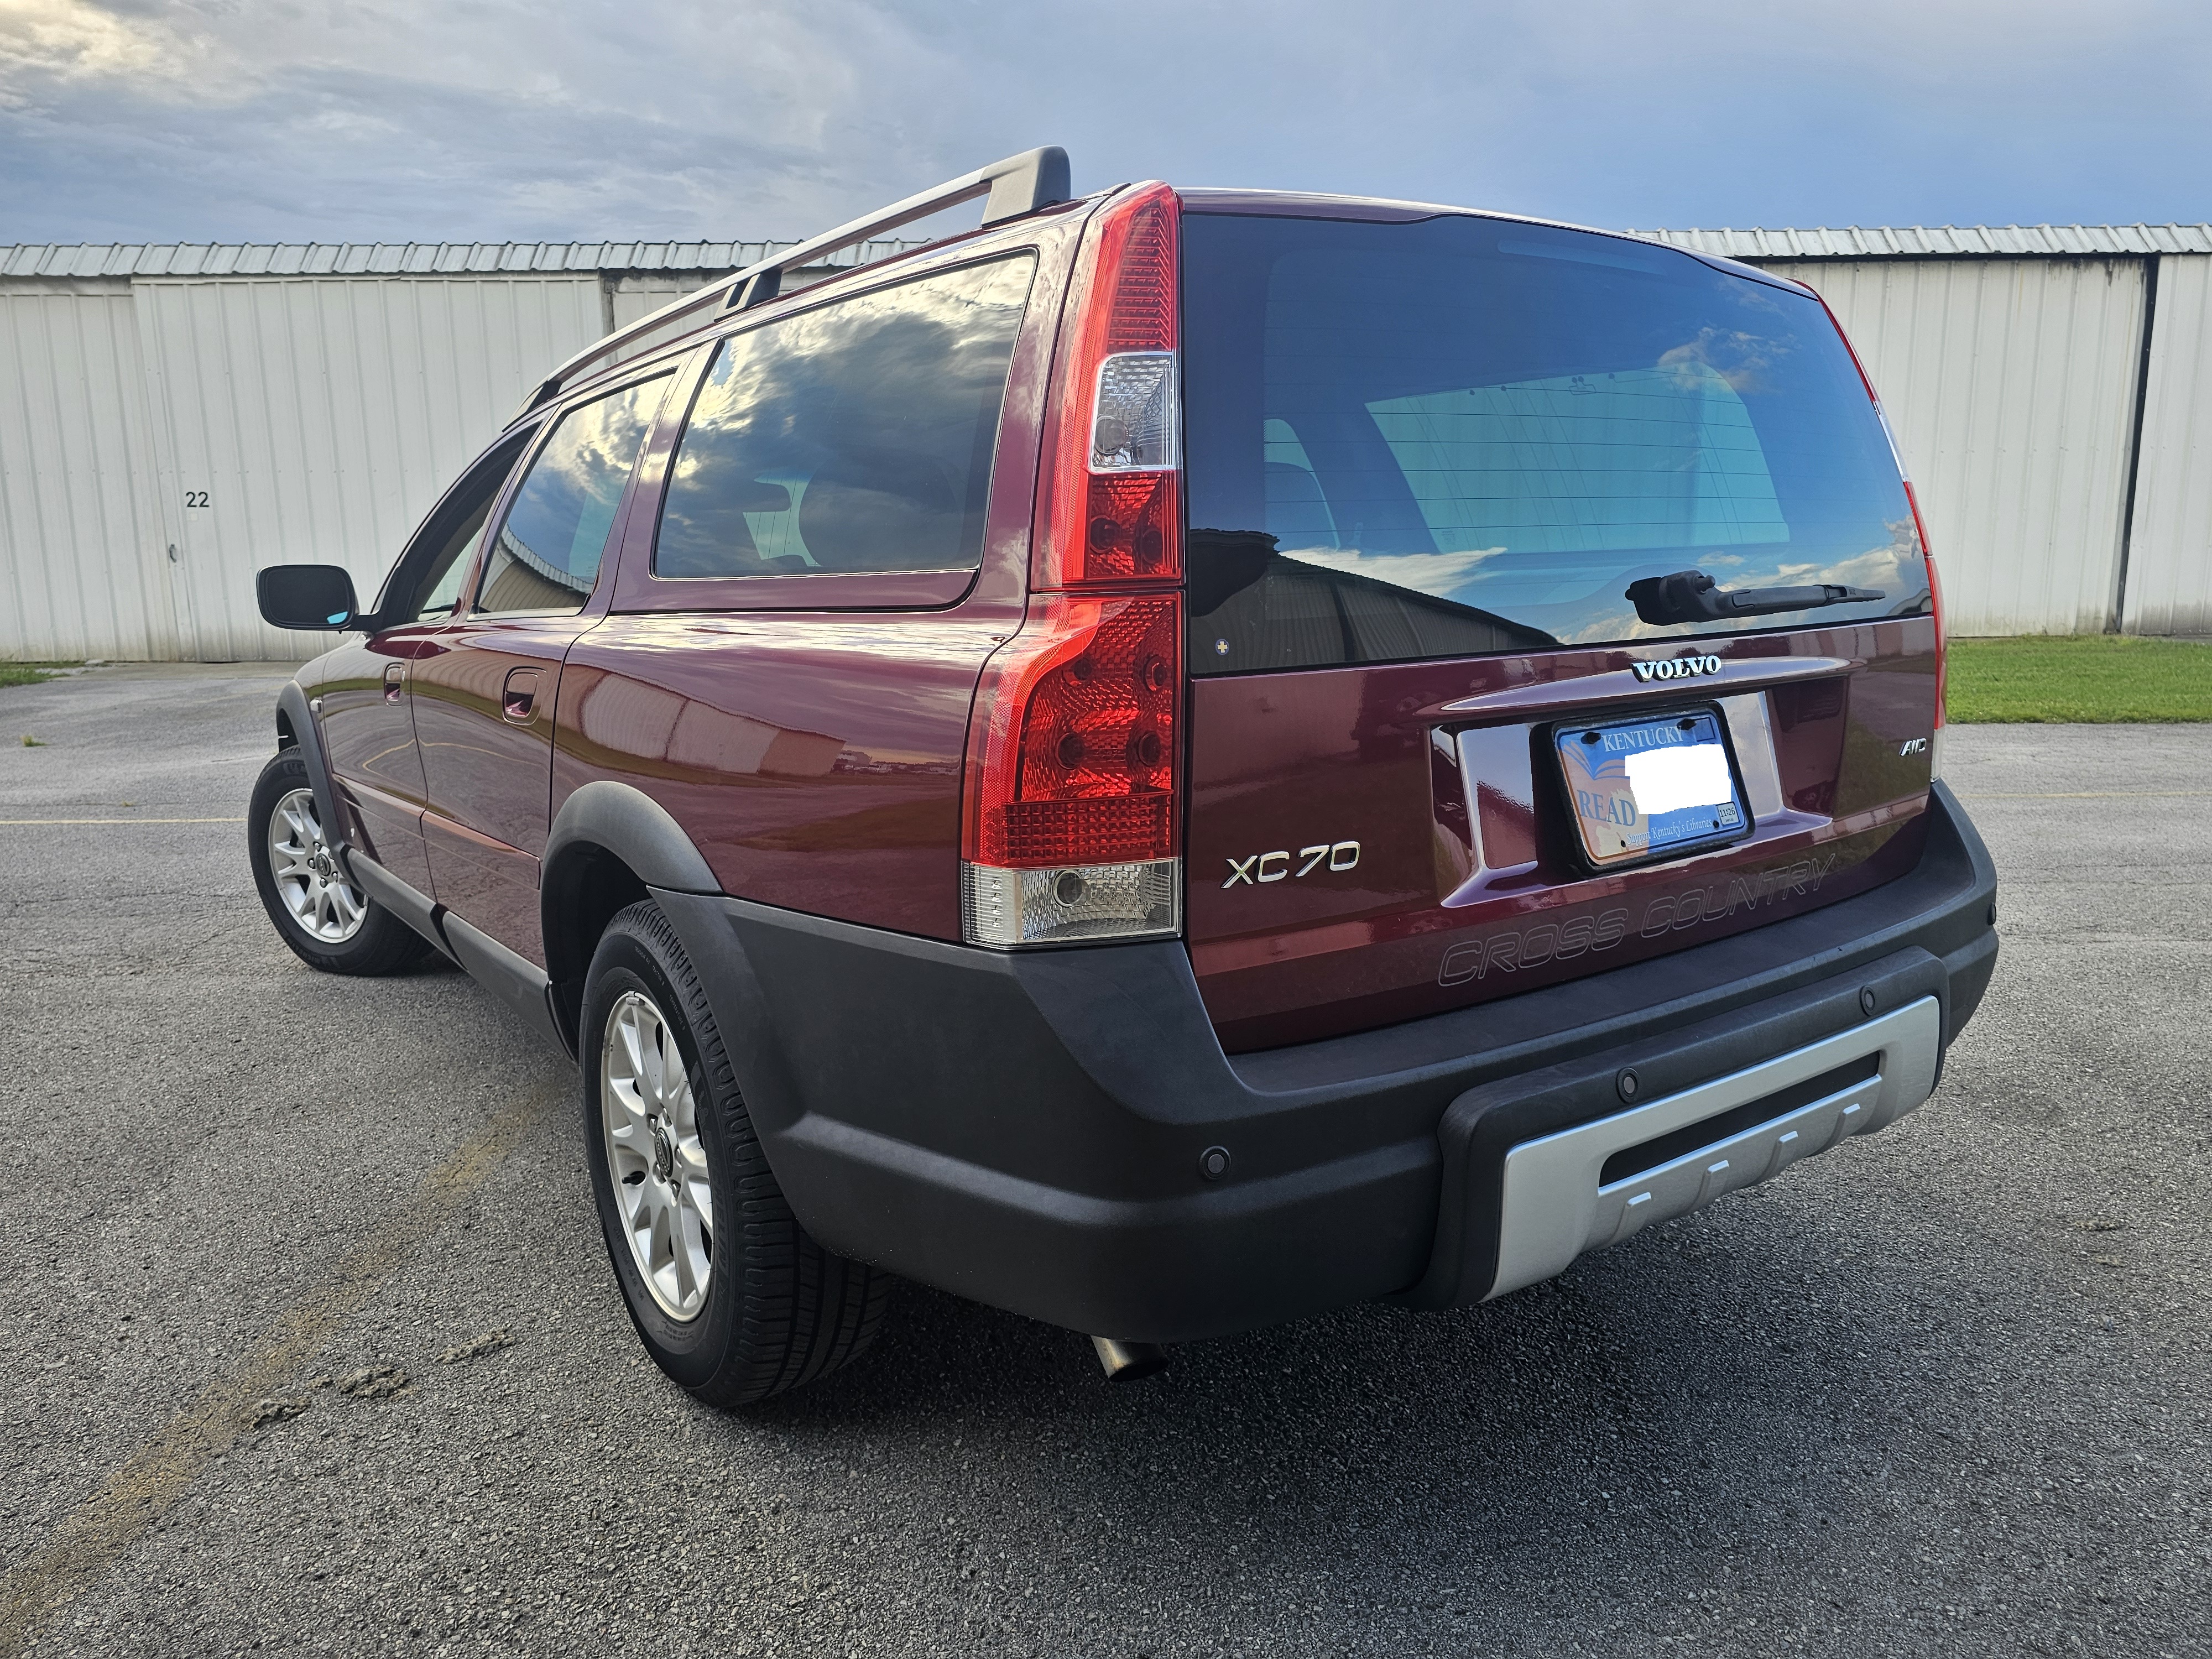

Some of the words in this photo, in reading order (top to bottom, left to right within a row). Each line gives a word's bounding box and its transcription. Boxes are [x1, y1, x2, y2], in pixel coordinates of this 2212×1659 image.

[185, 492, 210, 508] 22
[1633, 655, 1721, 682] VOLVO
[1603, 725, 1684, 752] KENTUCKY
[1577, 789, 1636, 827] READ
[1626, 831, 1651, 846] Support
[1651, 821, 1685, 839] Kentucky's
[1686, 817, 1712, 832] Libraries
[1438, 908, 1629, 987] CROSS
[1641, 853, 1836, 938] COUNTRY
